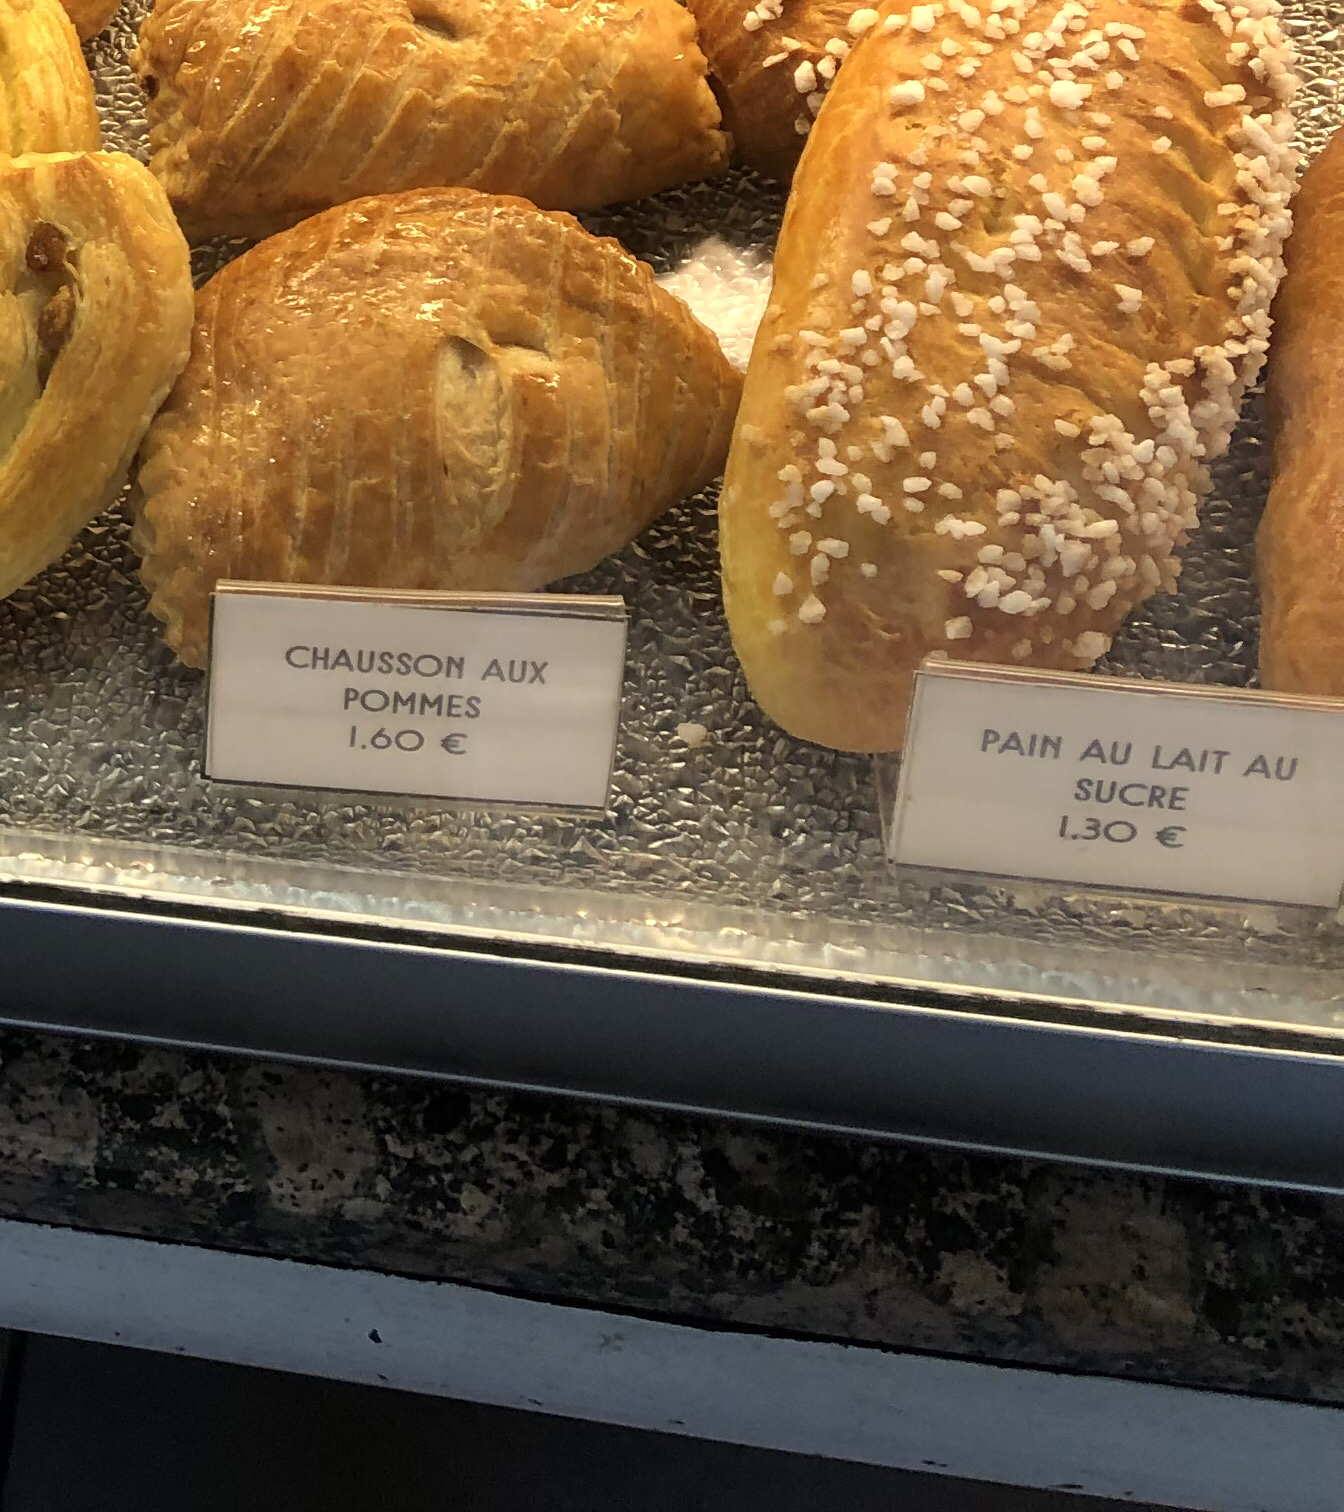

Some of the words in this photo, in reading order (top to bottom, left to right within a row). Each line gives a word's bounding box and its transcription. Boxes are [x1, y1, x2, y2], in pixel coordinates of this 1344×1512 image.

[285, 645, 465, 680] CHAUSSON
[481, 658, 549, 685] AUX
[344, 688, 481, 719] POMMES
[349, 725, 425, 752] 1.60
[441, 733, 468, 755] €
[980, 728, 1063, 760] PAIN
[1079, 738, 1133, 766] AU
[1151, 745, 1231, 775] LAIT
[1243, 755, 1299, 781] AU
[1074, 778, 1190, 811] SUCRE
[1059, 815, 1137, 843] 1.30
[1155, 826, 1187, 848] €
